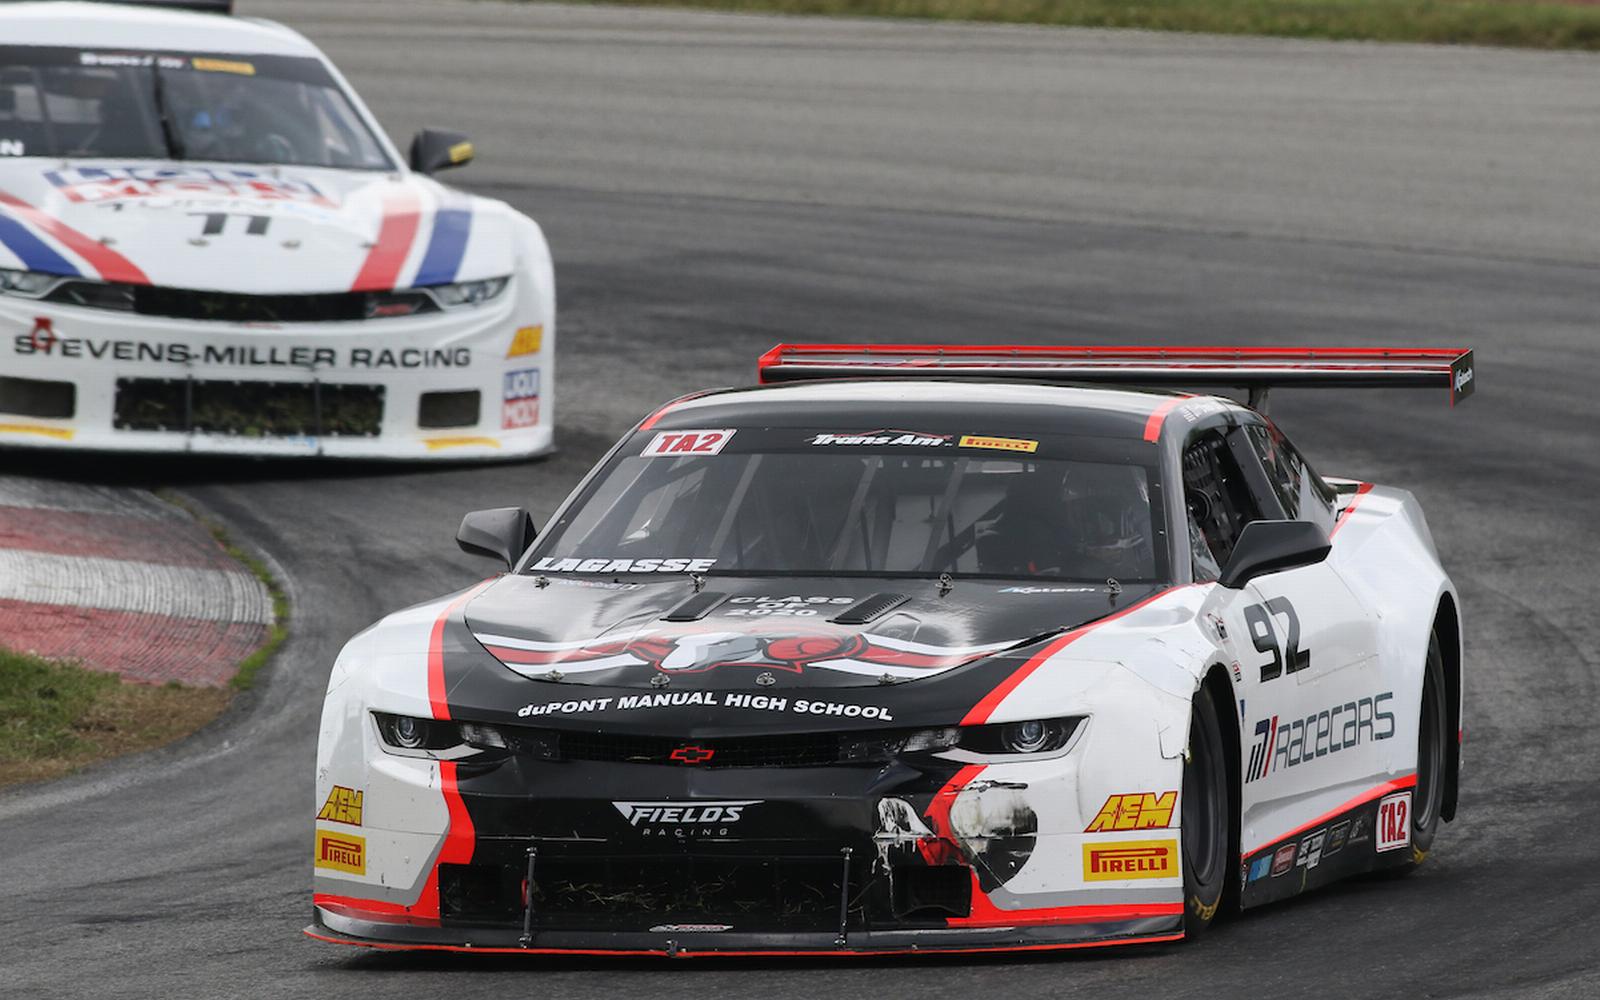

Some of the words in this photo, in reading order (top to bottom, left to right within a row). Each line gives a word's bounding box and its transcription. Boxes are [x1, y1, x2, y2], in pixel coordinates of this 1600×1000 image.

[14, 335, 337, 367] STEVENS-MILLER
[351, 348, 471, 369] RACING
[656, 433, 723, 453] TA2
[811, 434, 889, 446] Trans
[530, 557, 717, 573] LAGASSE
[723, 609, 818, 617] 2020
[730, 595, 855, 605] CLASS
[1243, 595, 1311, 684] 92
[517, 698, 612, 718] duPONT
[618, 691, 717, 710] MANUAL
[724, 693, 786, 711] HIGH
[793, 702, 894, 722] SCHOOL
[316, 784, 364, 827] AEM
[629, 806, 744, 827] FIELDS
[1083, 790, 1179, 834] AEM
[642, 828, 729, 836] RACING
[1380, 800, 1407, 844] TA2
[321, 836, 362, 868] PIRELLI
[1090, 847, 1169, 873] PIRELLI
